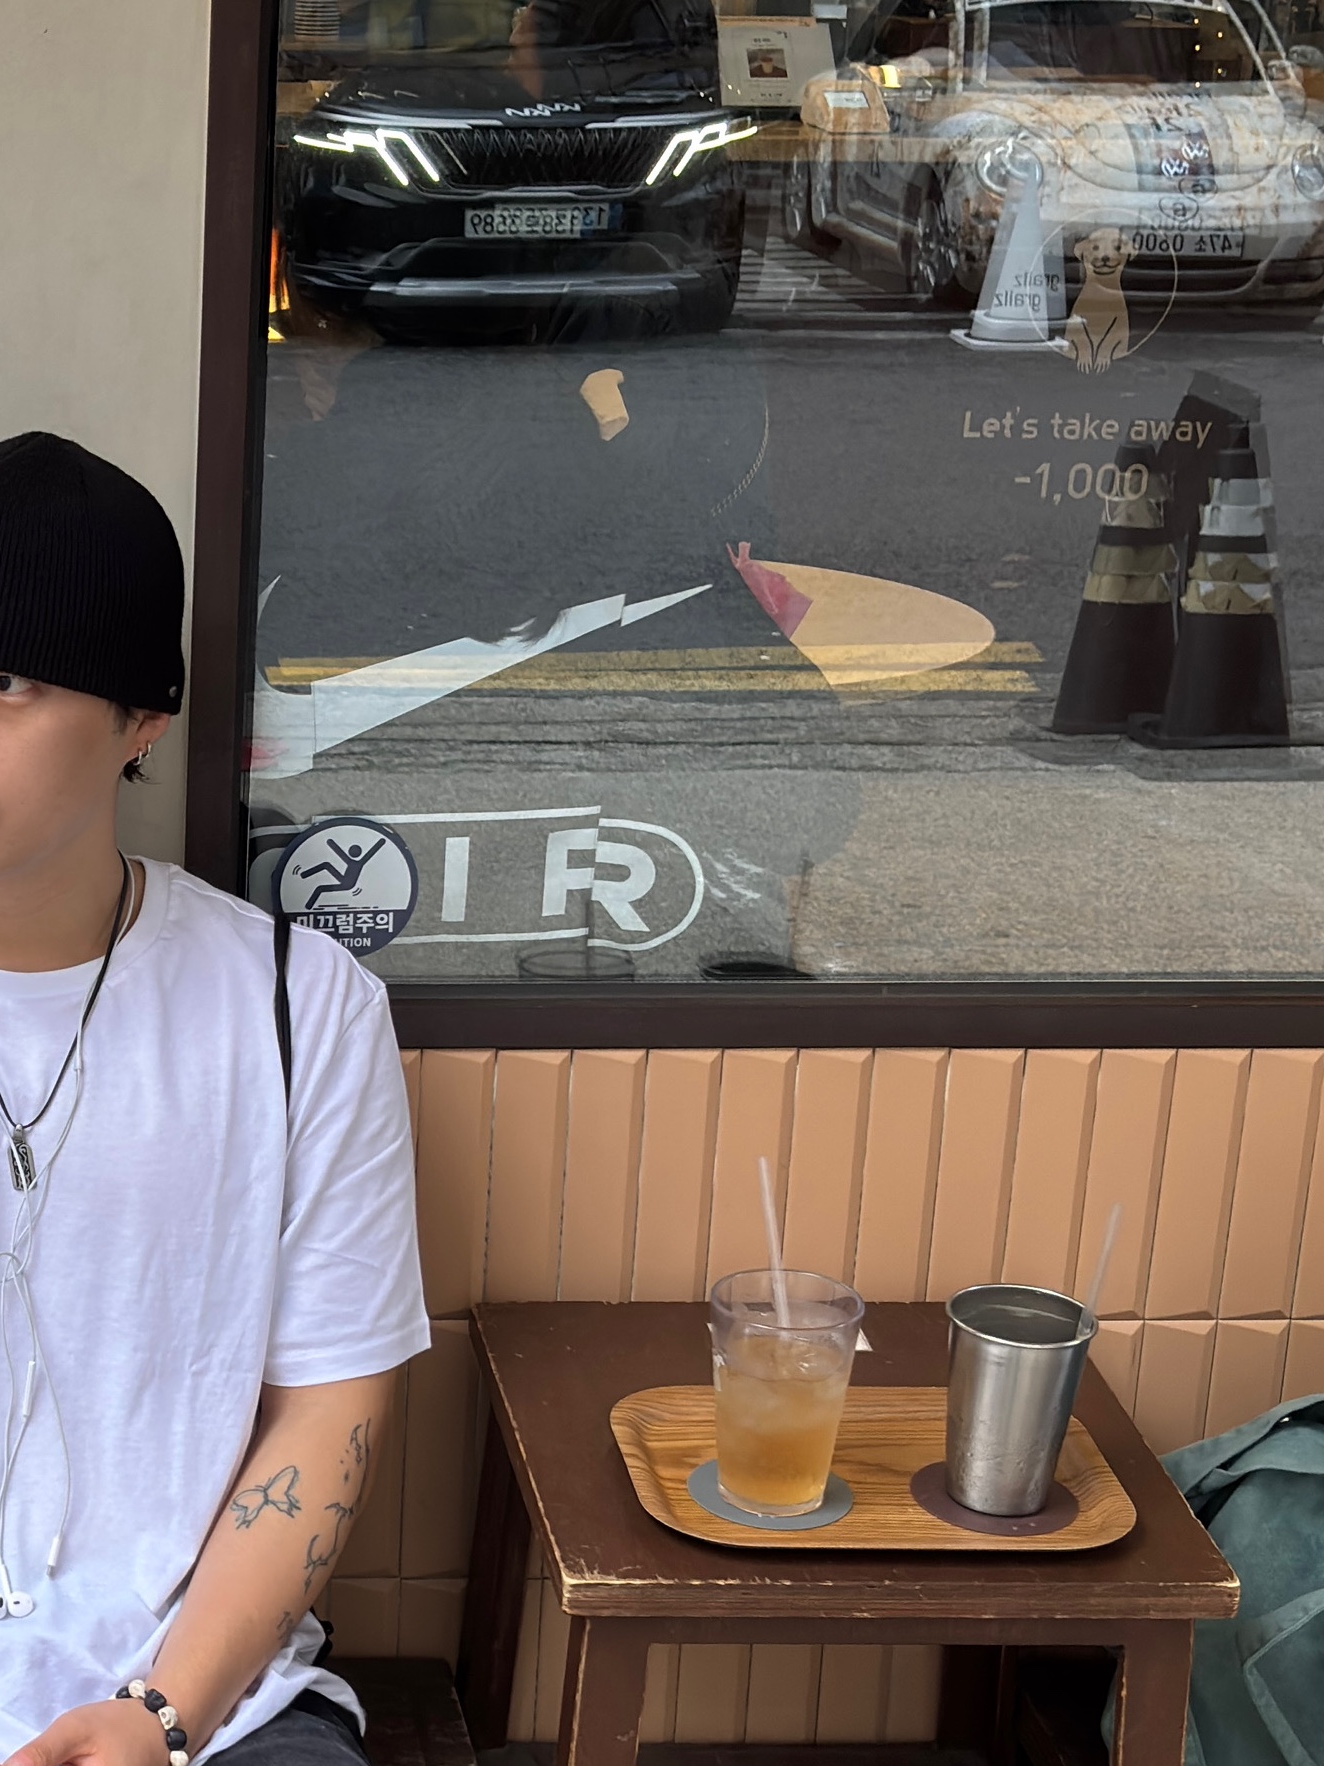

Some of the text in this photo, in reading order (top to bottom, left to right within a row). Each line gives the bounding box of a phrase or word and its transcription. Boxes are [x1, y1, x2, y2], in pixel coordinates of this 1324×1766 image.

[962, 406, 1214, 450] Let's take away
[1013, 461, 1150, 506] -1,000
[296, 911, 395, 934] 미끄럼주의
